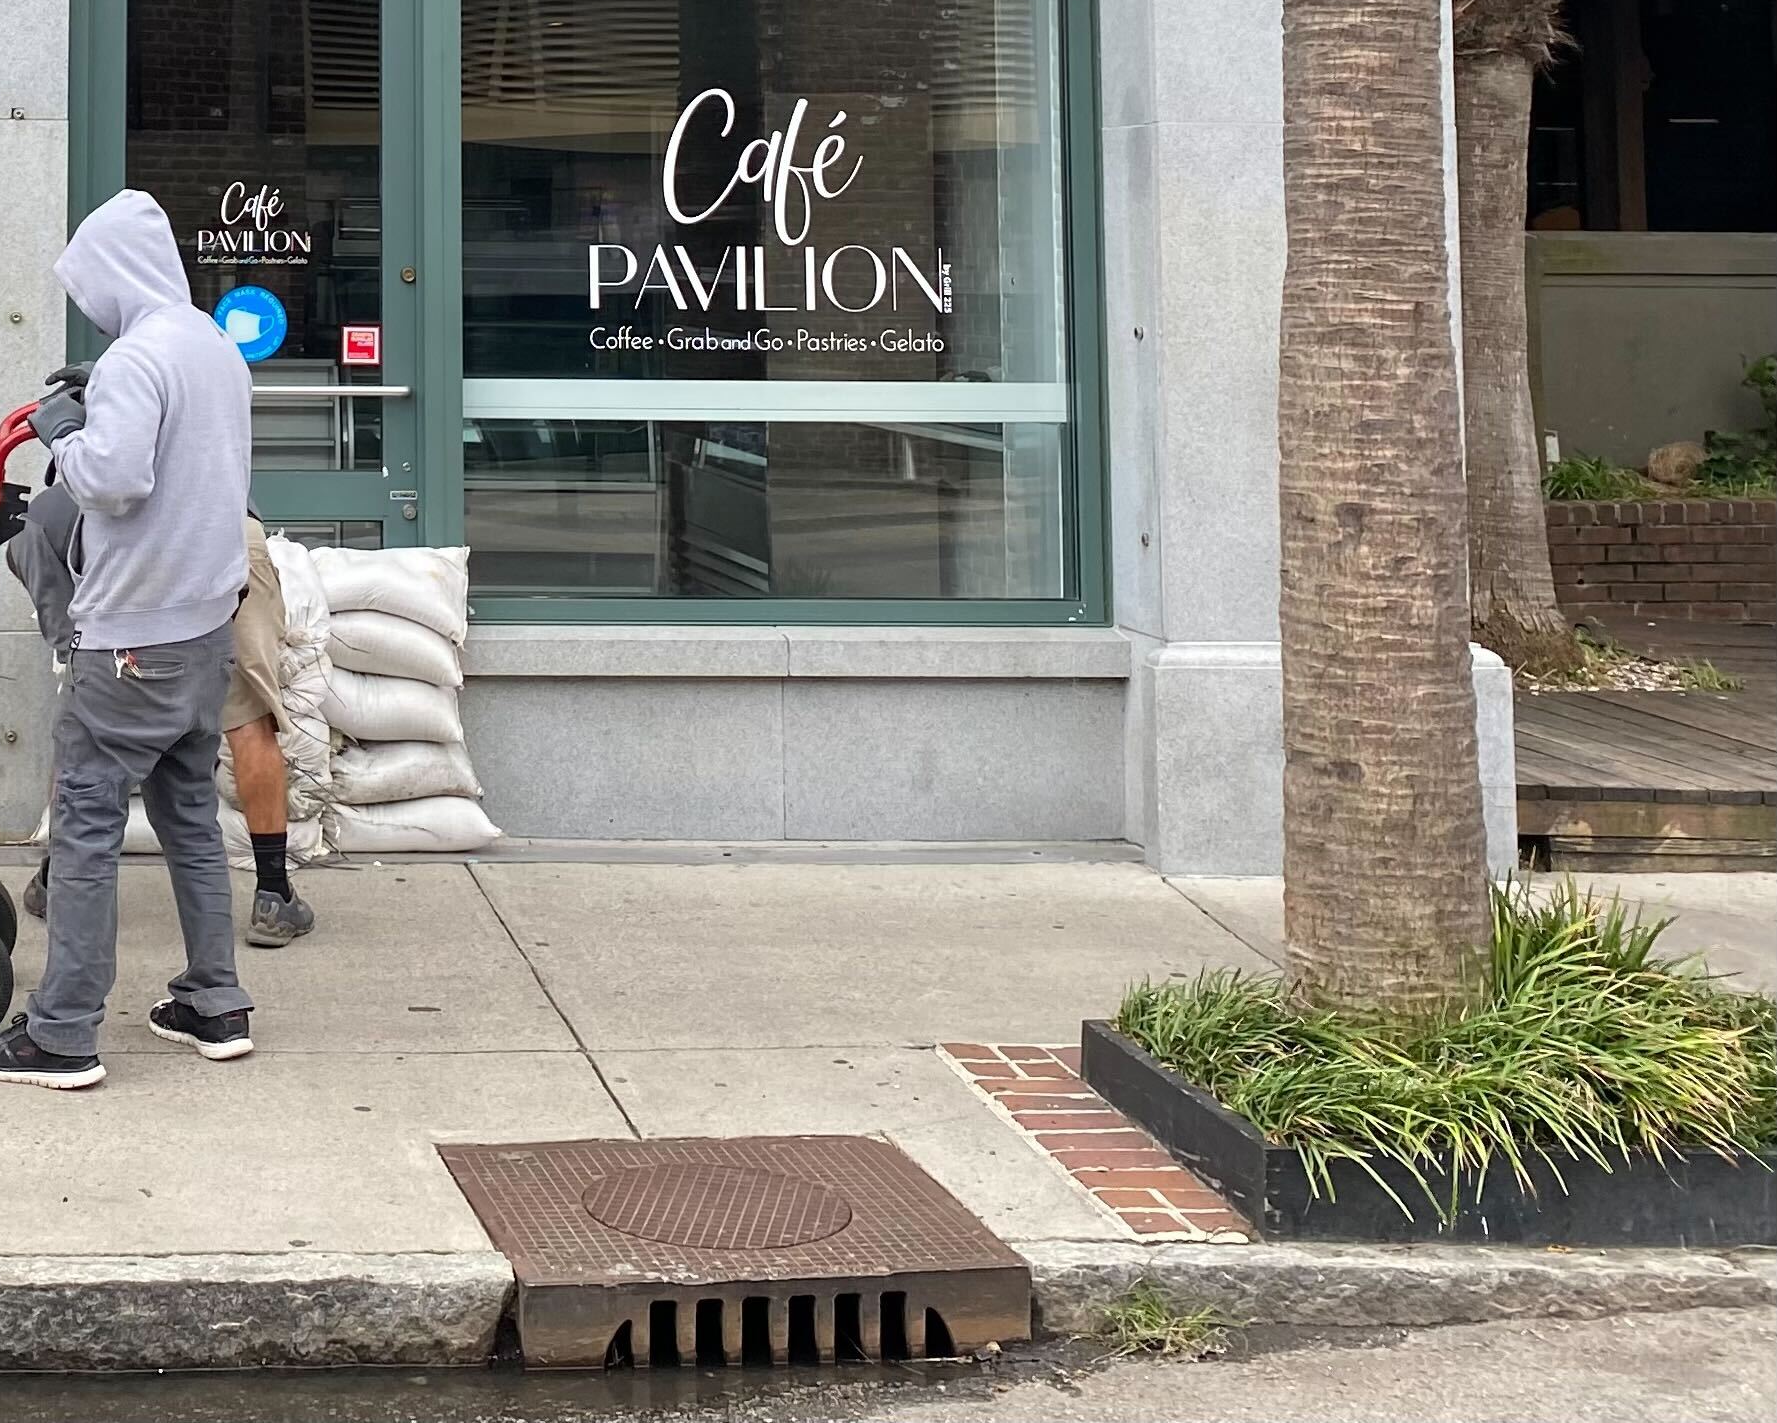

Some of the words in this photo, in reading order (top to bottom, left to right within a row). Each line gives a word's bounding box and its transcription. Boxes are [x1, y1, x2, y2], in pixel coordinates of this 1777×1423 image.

[662, 87, 864, 247] Café
[220, 181, 285, 232] Café
[197, 229, 310, 253] PAVILION
[589, 243, 943, 314] PAVILION
[941, 263, 952, 276] by
[943, 296, 953, 314] 225
[589, 326, 654, 352] Coffee
[667, 326, 719, 352] Grab
[721, 326, 751, 352] and
[754, 326, 784, 352] Go
[797, 326, 868, 352] Pastries
[880, 326, 945, 352] Gelato
